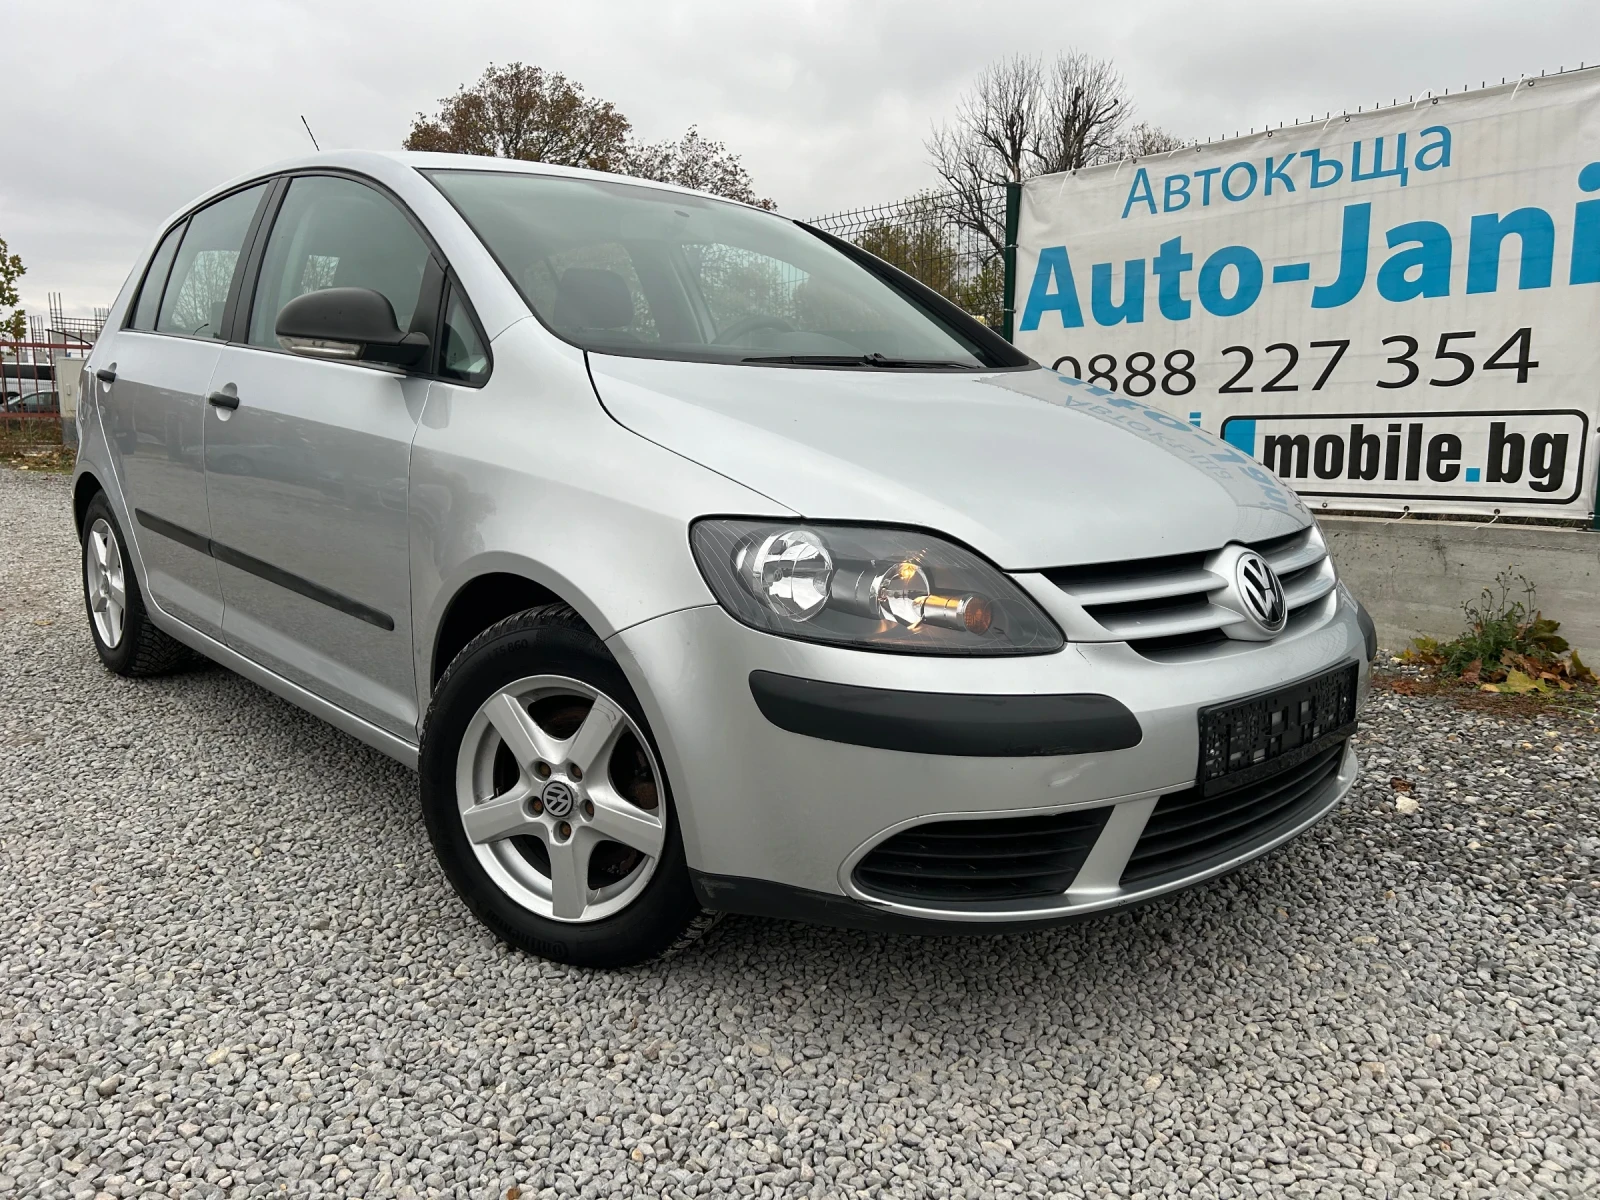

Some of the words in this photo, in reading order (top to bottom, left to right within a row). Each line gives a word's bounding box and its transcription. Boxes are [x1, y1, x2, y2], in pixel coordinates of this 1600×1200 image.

[1120, 124, 1452, 219] Автокъща
[1018, 161, 1600, 332] Auto-Jani
[1217, 339, 1351, 395] 227
[1375, 327, 1540, 389] 354
[1262, 421, 1570, 493] mobile.bg
[507, 638, 529, 653] 860
